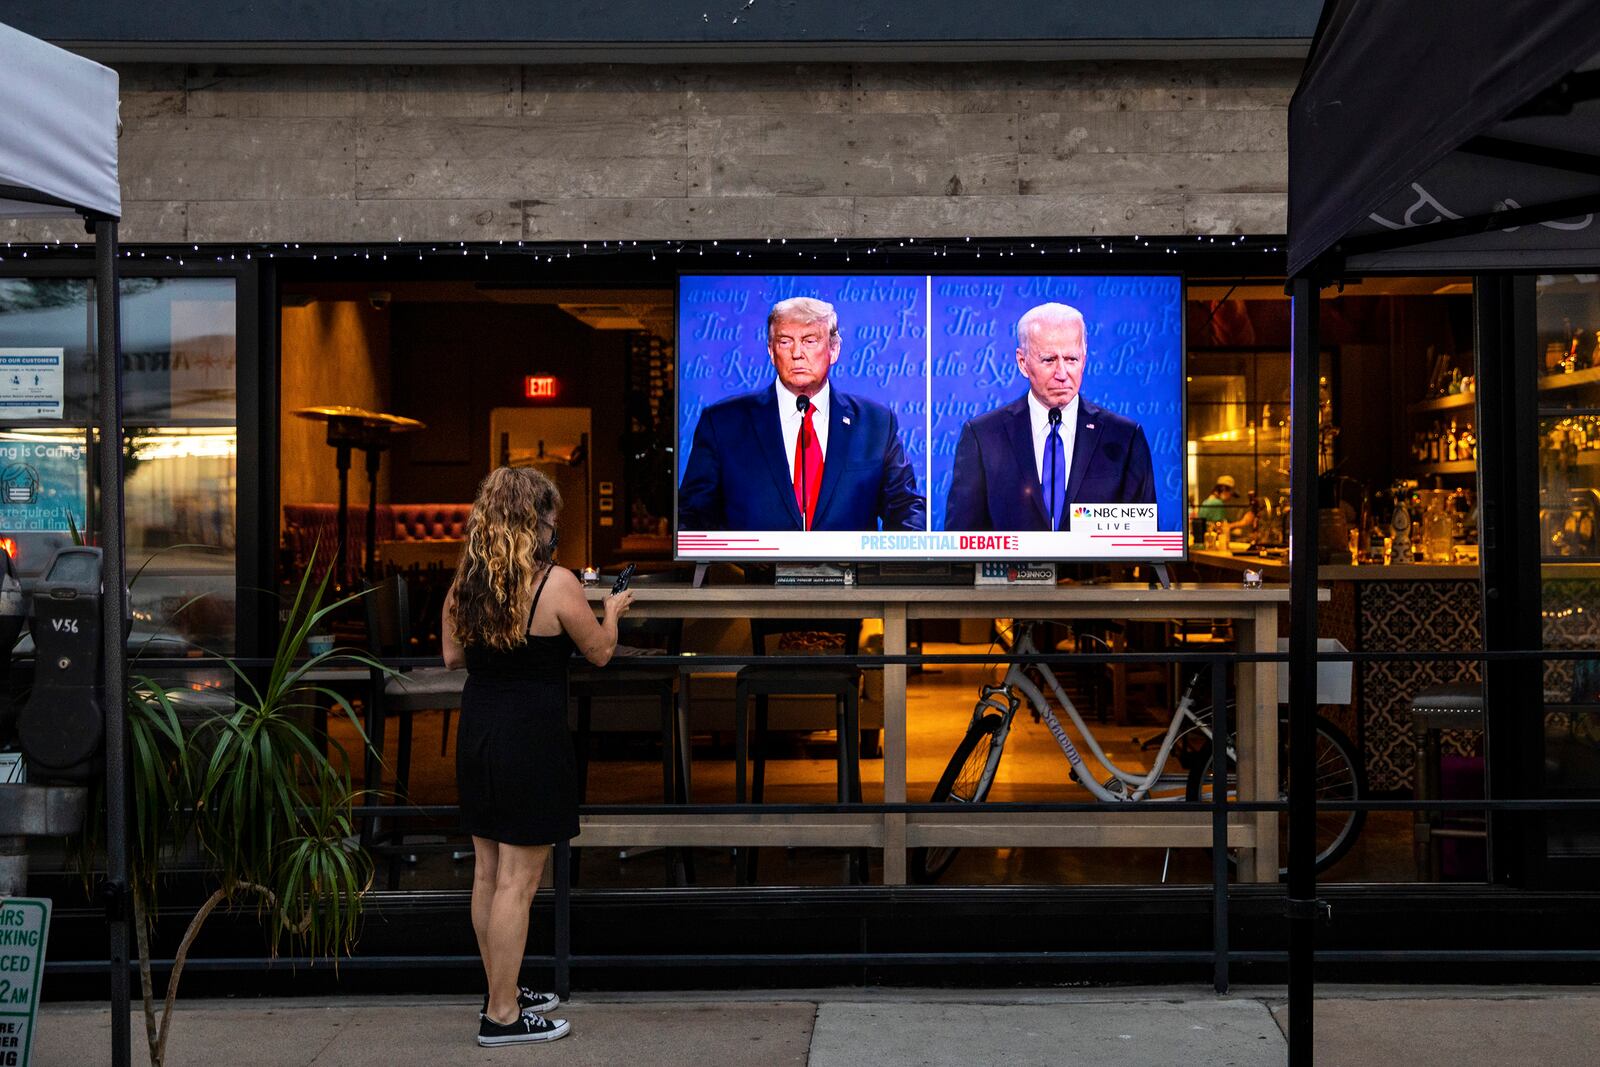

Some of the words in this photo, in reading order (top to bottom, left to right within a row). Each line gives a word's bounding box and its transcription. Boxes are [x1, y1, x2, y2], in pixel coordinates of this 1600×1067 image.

[530, 378, 554, 396] EXIT
[21, 445, 31, 458] is
[35, 445, 80, 460] Caring
[8, 506, 58, 519] required
[1093, 507, 1118, 518] NBC
[1121, 507, 1154, 518] NEWS
[15, 519, 26, 530] at
[30, 518, 44, 530] all
[1097, 522, 1131, 531] LIVE
[861, 535, 958, 550] PRESIDENTIAL
[959, 535, 1011, 550] DEBATE
